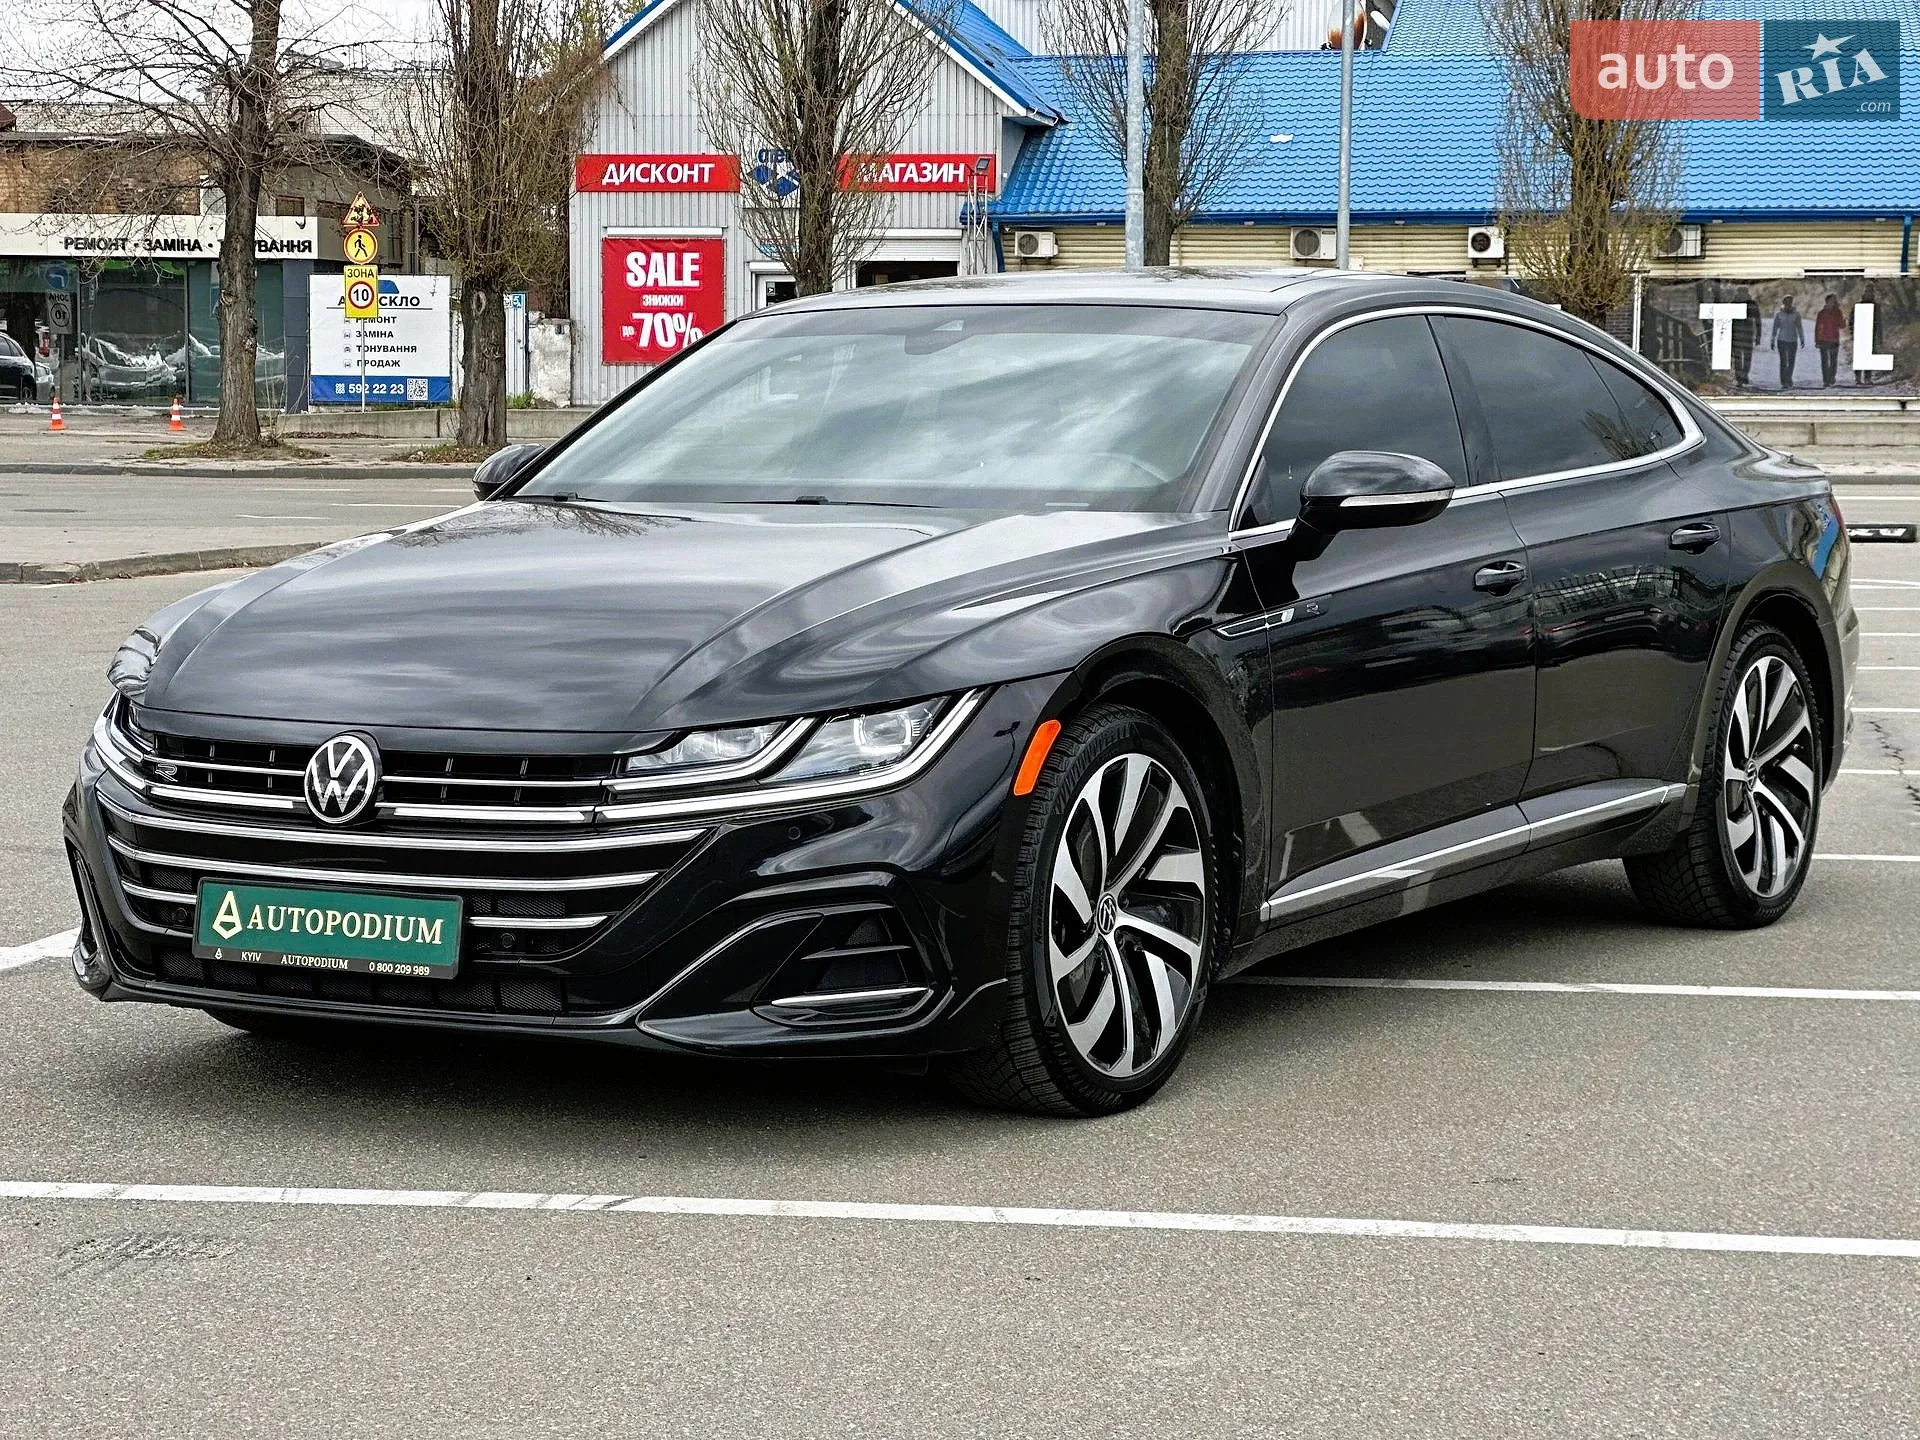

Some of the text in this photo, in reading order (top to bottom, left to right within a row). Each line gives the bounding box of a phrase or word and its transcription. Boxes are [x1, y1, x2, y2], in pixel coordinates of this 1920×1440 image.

[601, 162, 715, 186] ДИСКОНТ
[63, 236, 126, 251] РЕМОНТ
[143, 238, 203, 252] ЗАМІНА
[347, 268, 374, 278] ЗОНА
[625, 251, 700, 288] SALE
[353, 288, 369, 302] 10
[642, 294, 684, 307] ЗНИЖКИ
[355, 330, 394, 338] ЗАМІНА
[631, 312, 704, 348] 70%
[1699, 303, 1894, 370] T L
[356, 345, 417, 353] ТОНУВАННЯ
[349, 383, 404, 394] 592 22 23
[247, 904, 444, 945] AUTOPODIUM
[241, 951, 430, 976] KYIV AUTOPODIUM 0 800 209 989
